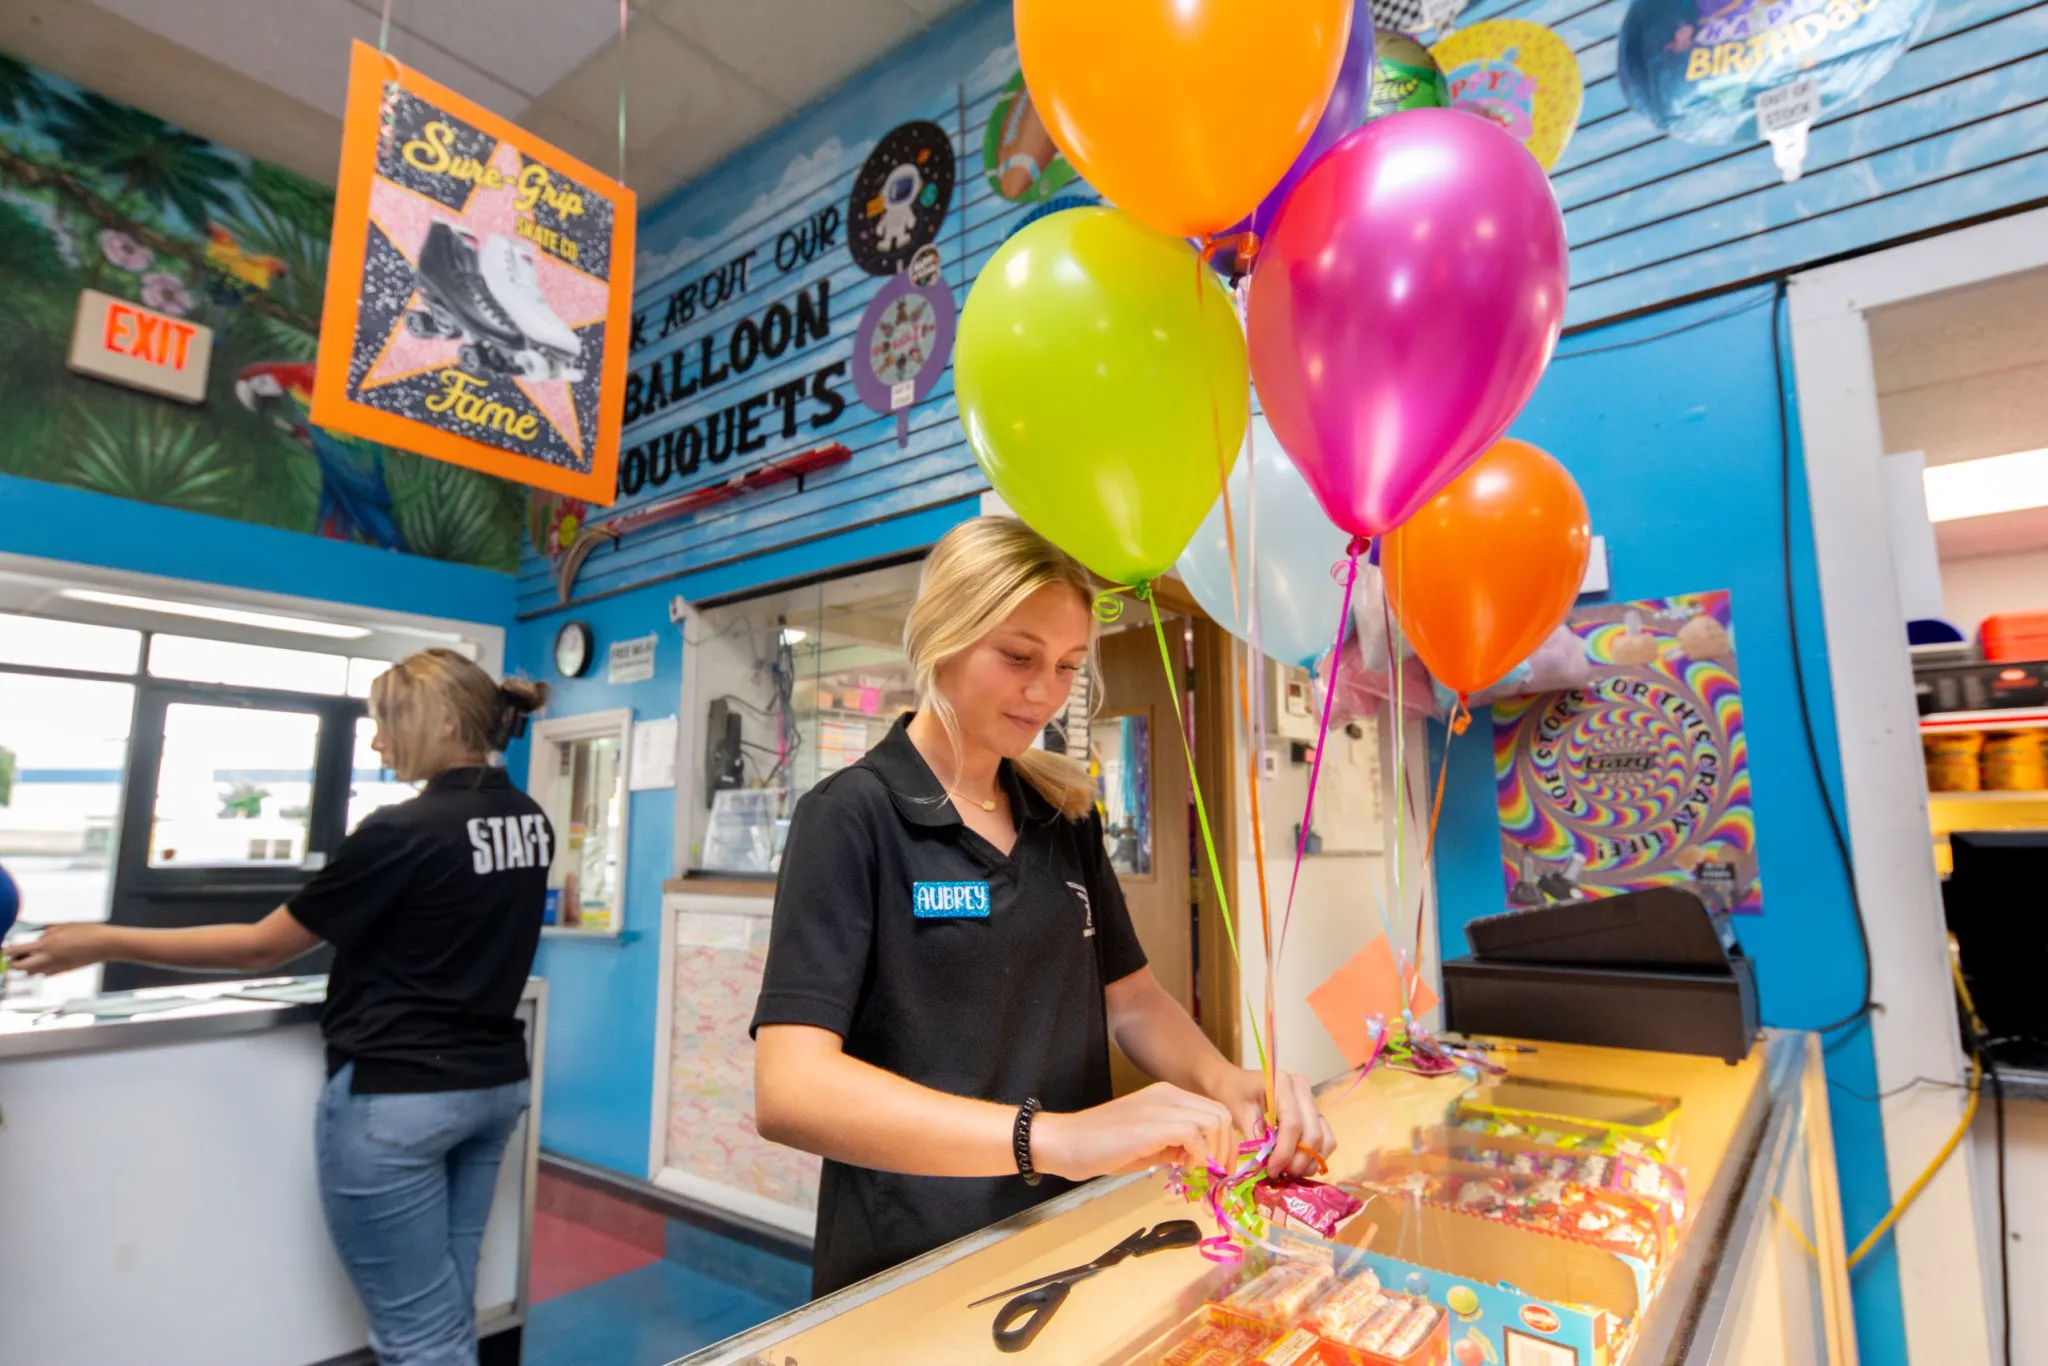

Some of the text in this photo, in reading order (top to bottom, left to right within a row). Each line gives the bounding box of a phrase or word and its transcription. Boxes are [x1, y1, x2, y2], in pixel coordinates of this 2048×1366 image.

[402, 121, 585, 219] Sure-Grip
[515, 216, 560, 252] SKATE
[660, 250, 756, 338] ABOUT
[774, 206, 840, 272] OUR
[104, 303, 196, 371] EXIT
[623, 279, 830, 424] BALLOON
[425, 369, 539, 440] Fame
[616, 361, 846, 496] OUQUETS
[1536, 689, 1585, 760] STOPS
[1660, 692, 1711, 742] THIS
[1672, 753, 1717, 834] CRAZY
[467, 814, 550, 875] STAFF
[1597, 830, 1664, 860] LIFE!
